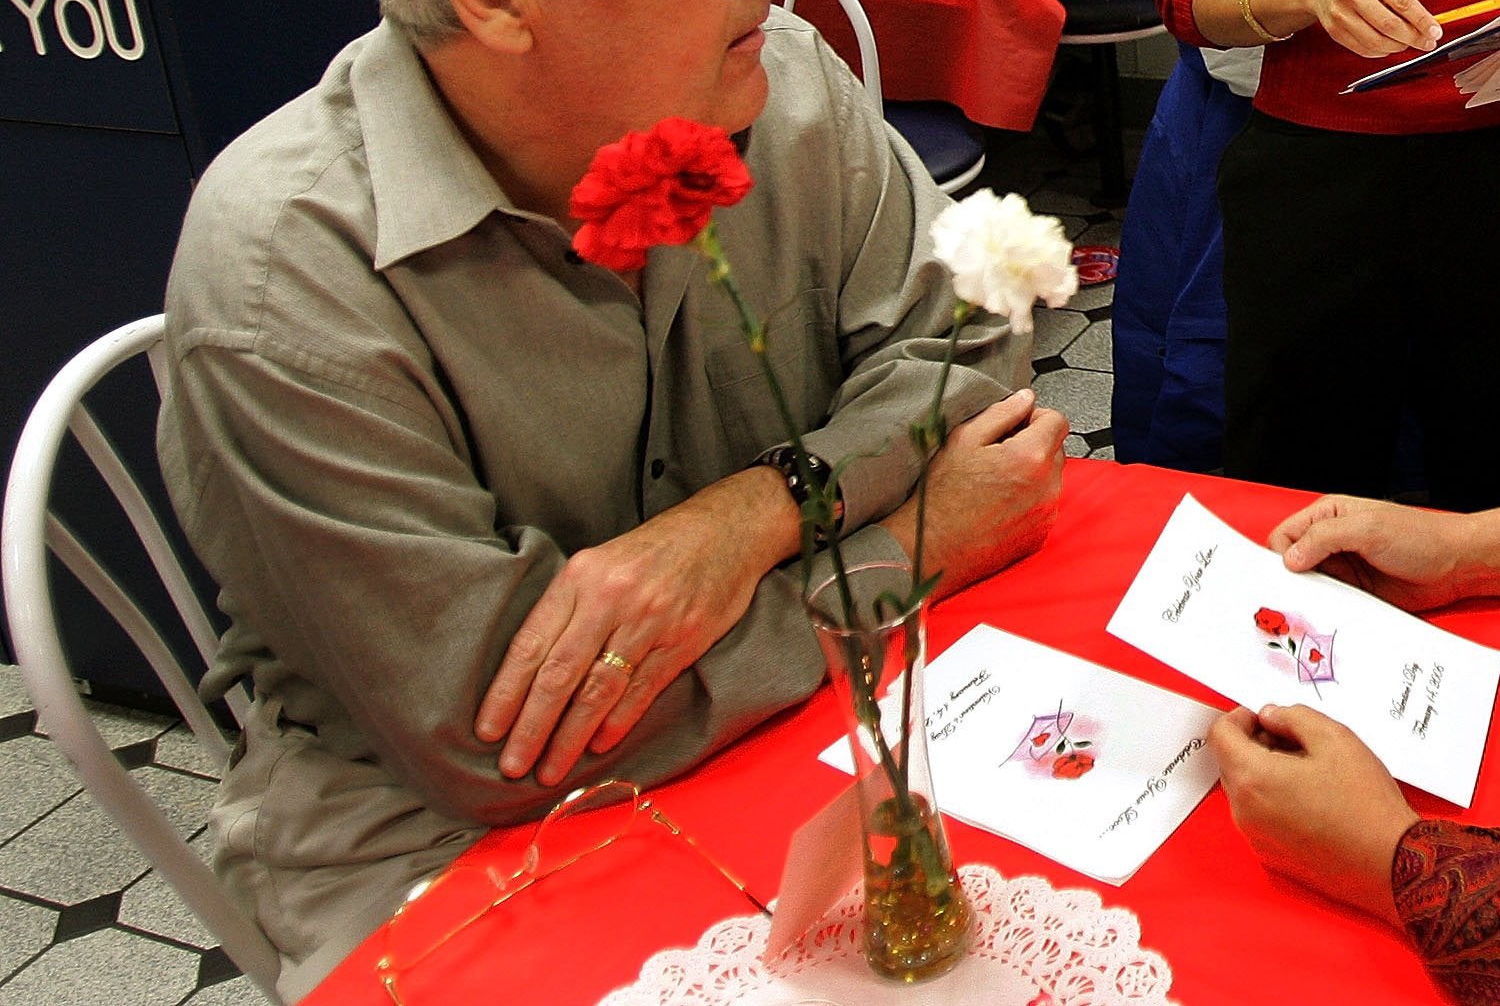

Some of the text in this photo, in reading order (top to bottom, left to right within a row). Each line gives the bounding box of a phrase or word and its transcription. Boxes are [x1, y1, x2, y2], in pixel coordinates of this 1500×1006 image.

[1402, 662, 1424, 683] Day
[1162, 738, 1207, 777] Celebrate
[1136, 776, 1167, 805] Your
